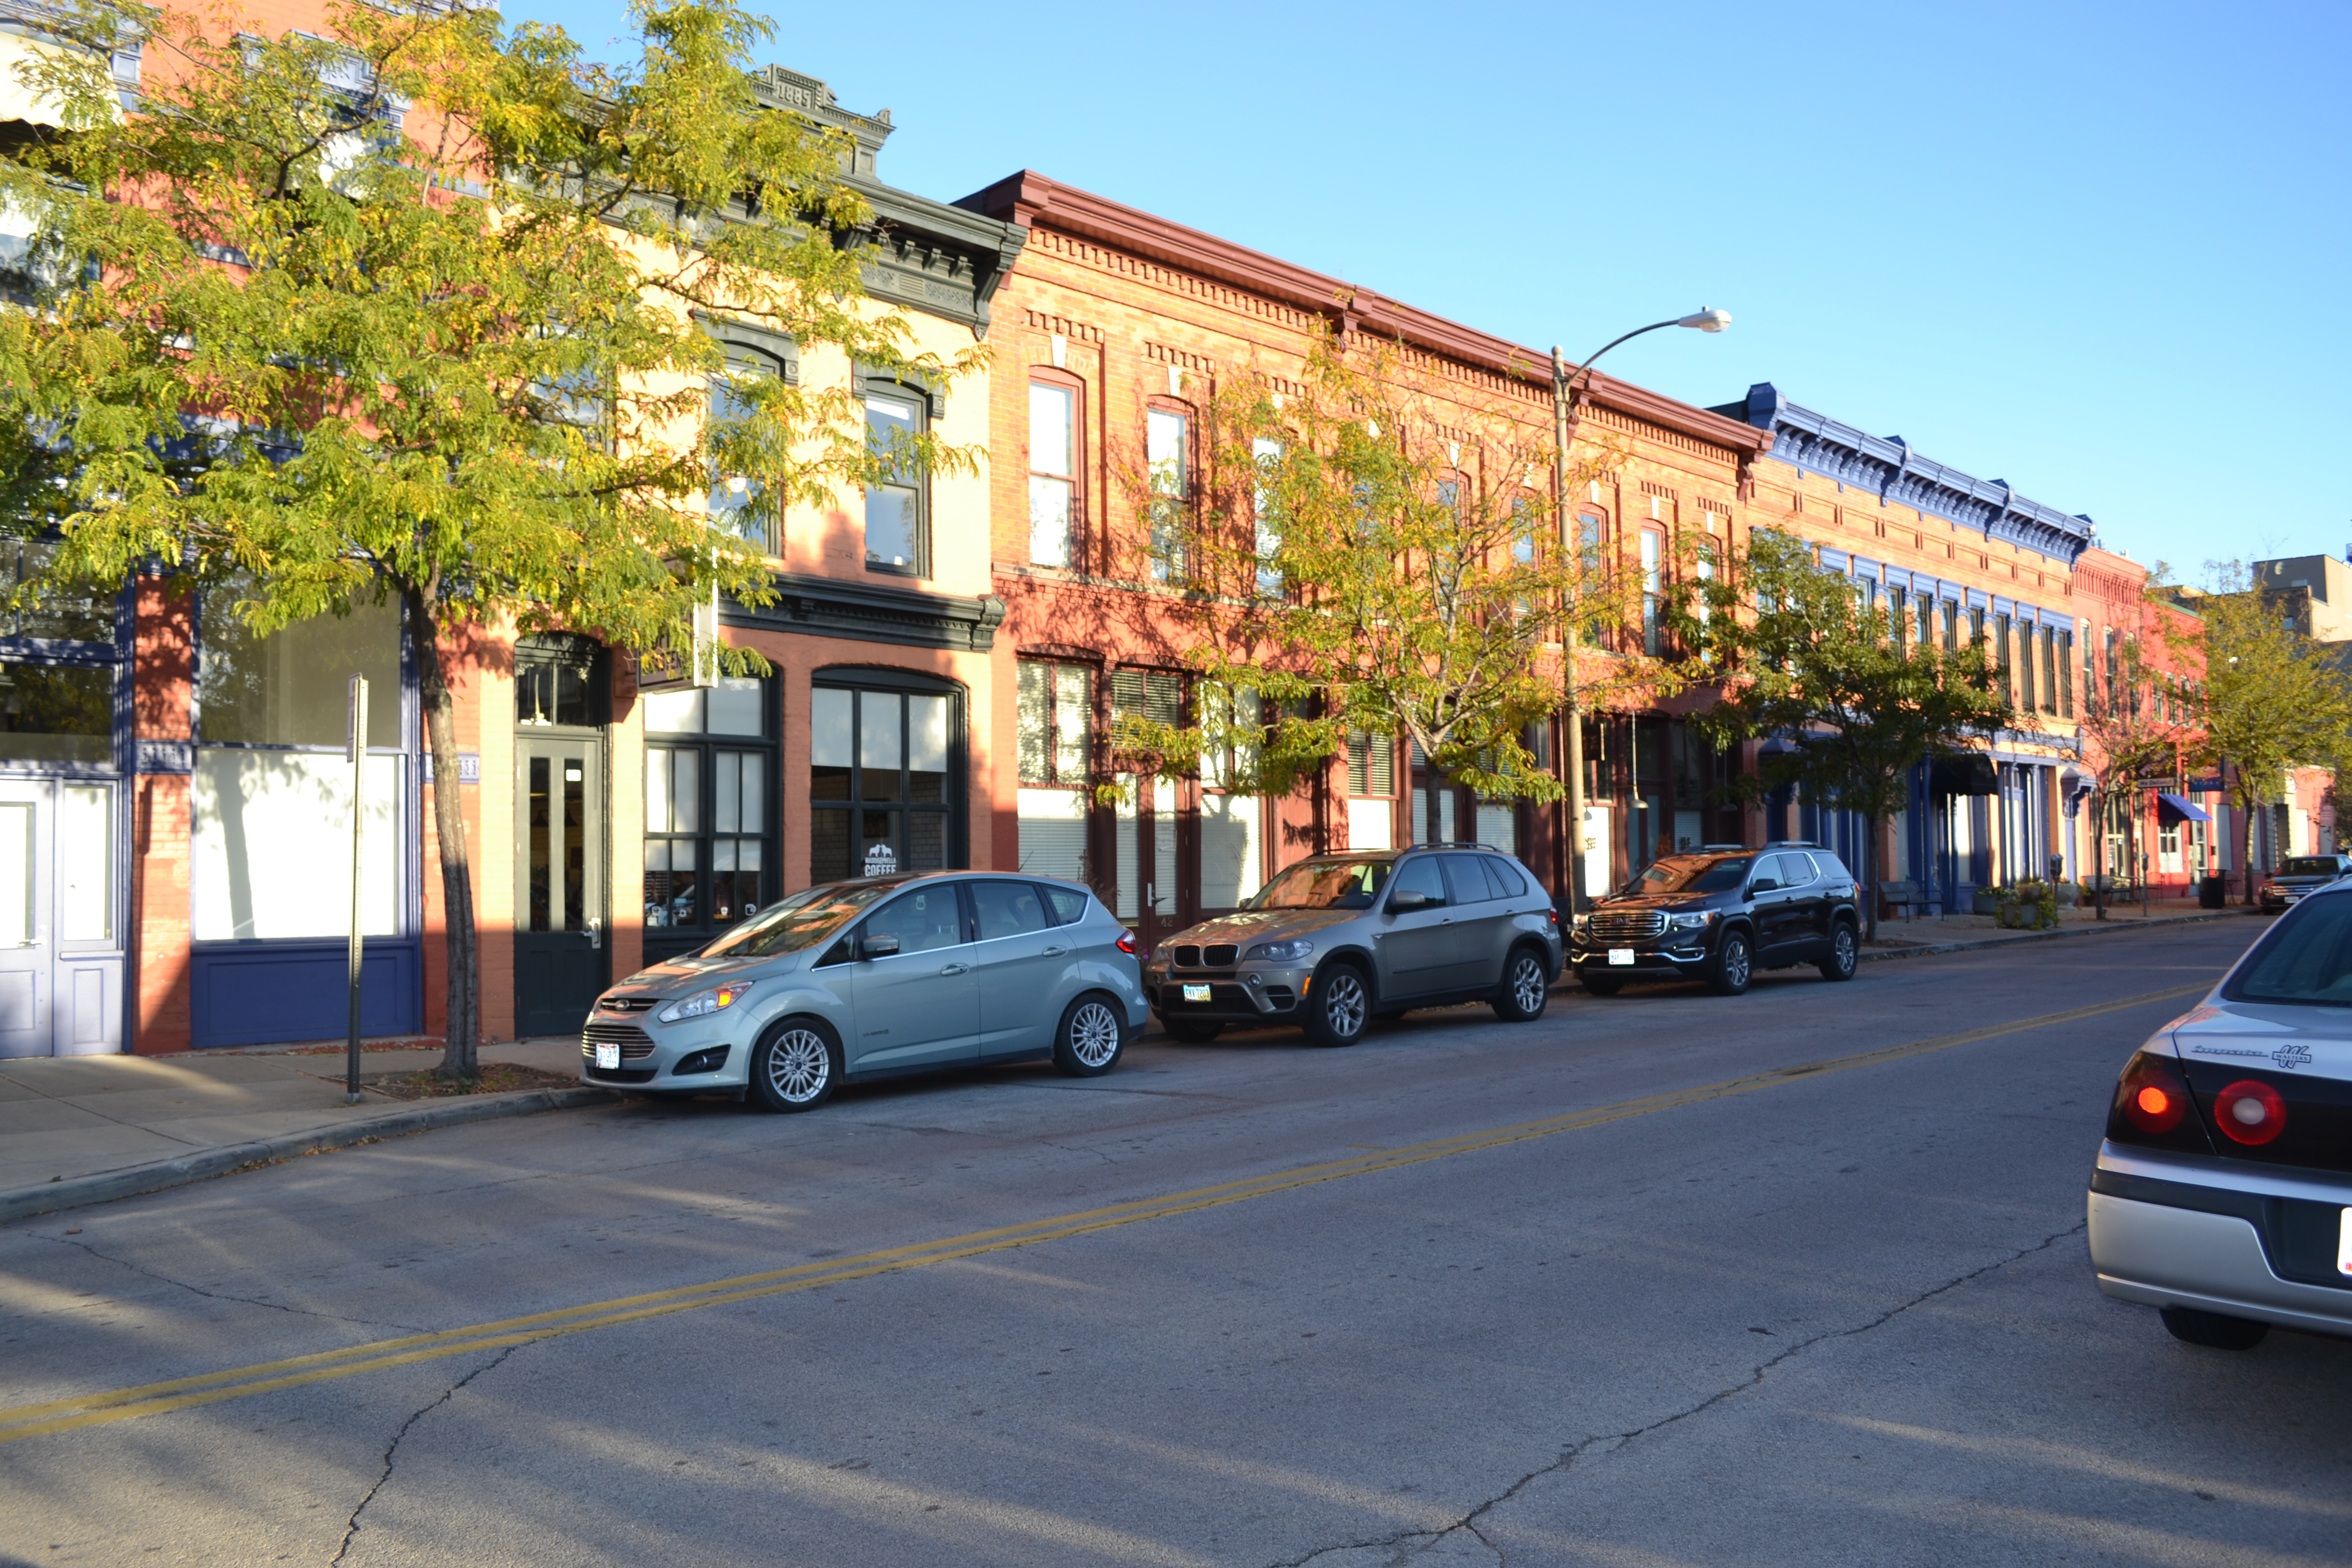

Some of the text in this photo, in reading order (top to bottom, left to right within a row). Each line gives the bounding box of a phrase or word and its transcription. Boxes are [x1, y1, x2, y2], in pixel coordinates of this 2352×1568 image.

[778, 84, 811, 107] 1885
[865, 864, 896, 877] COFFEE
[2276, 1054, 2308, 1062] WALTERS
